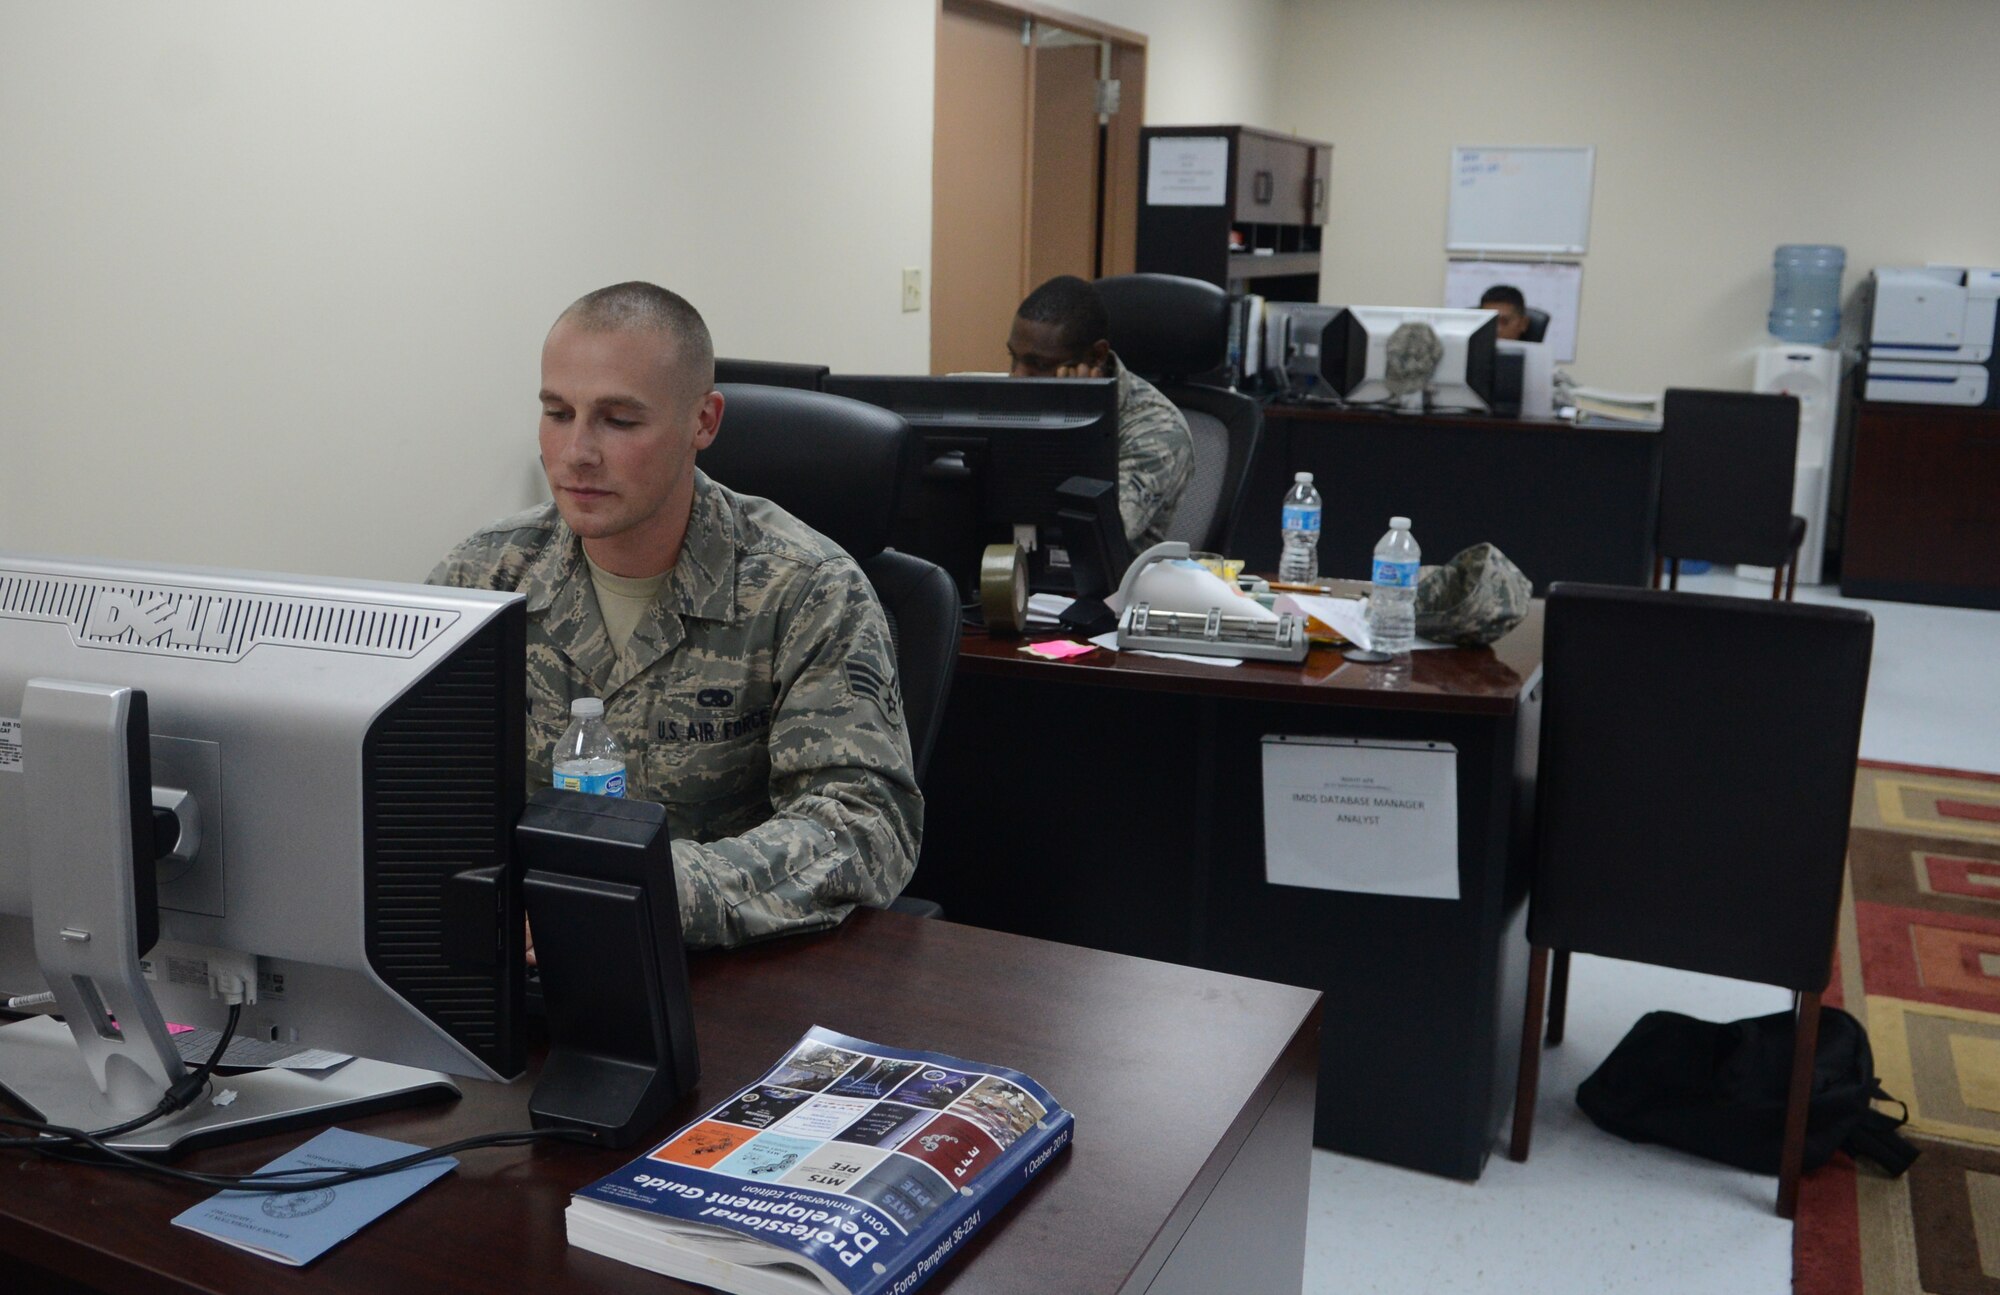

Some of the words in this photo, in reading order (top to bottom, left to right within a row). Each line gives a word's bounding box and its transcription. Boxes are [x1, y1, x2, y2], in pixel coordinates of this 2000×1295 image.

[90, 591, 232, 650] DELL
[658, 720, 681, 740] U.S.
[687, 723, 715, 742] AIR
[724, 709, 771, 739] FORCE
[1293, 793, 1318, 804] IMDS
[1320, 794, 1370, 807] DATABASE
[1373, 797, 1425, 811] MANAGER
[1337, 812, 1381, 826] ANALYST
[828, 1162, 864, 1174] PFE
[954, 1146, 980, 1178] PFE
[1023, 1166, 1029, 1179] 1
[1029, 1145, 1053, 1174] October
[1052, 1130, 1068, 1149] 2013
[632, 1174, 704, 1199] Guide
[741, 1185, 788, 1201] Edition
[807, 1174, 848, 1187] MTS
[901, 1180, 932, 1207] PFE
[788, 1190, 862, 1213] Anniversary
[882, 1193, 915, 1221] MTS
[699, 1206, 864, 1267] Professional
[704, 1193, 880, 1255] Development
[861, 1210, 890, 1237] 40th
[893, 1270, 918, 1295] Force
[916, 1236, 953, 1278] Pamphlet
[952, 1210, 981, 1244] 36-2241
